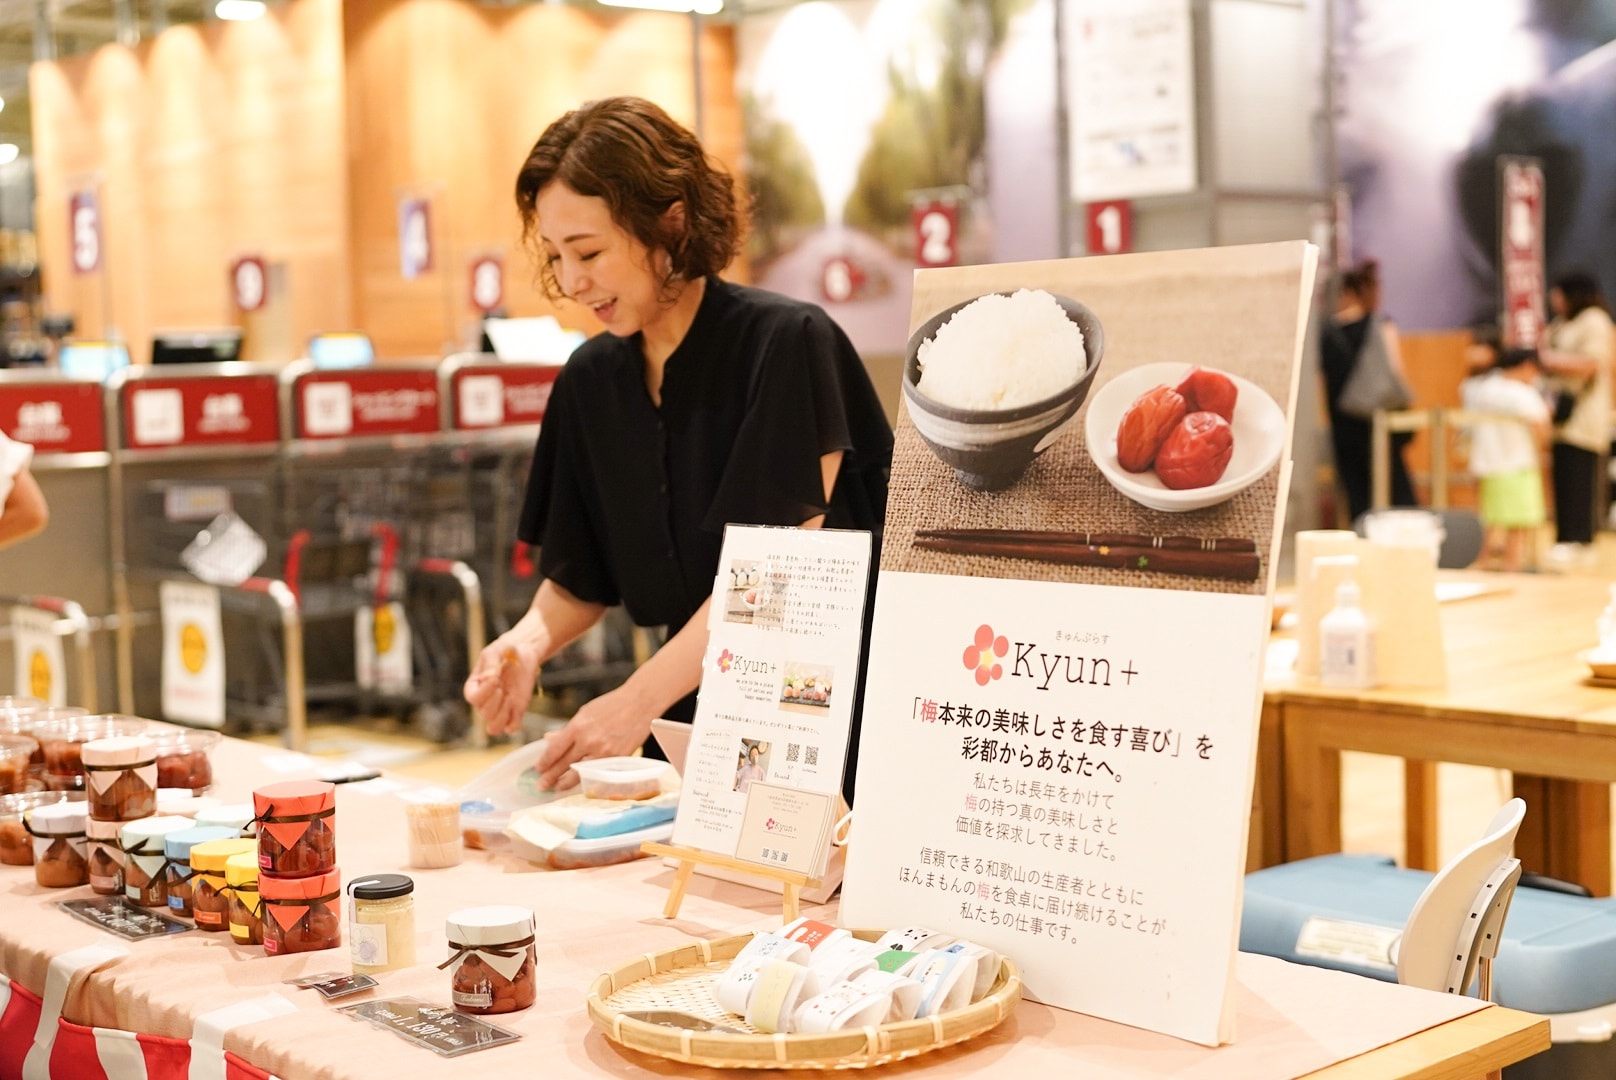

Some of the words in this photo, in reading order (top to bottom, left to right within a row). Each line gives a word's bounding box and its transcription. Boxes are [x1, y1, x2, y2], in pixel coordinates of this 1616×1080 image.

[75, 207, 98, 269] 5
[921, 212, 951, 264] 2
[1096, 206, 1121, 252] 1
[1055, 629, 1110, 645] きゅんぷらす
[733, 655, 777, 675] Kyun+
[1011, 642, 1138, 690] Kyun+
[912, 697, 1213, 760] 「梅本来の美味しさを食す喜び」を
[961, 735, 1122, 783] 彩都からあなたへ。
[973, 772, 1114, 810] 私たちは長年をかけて
[956, 815, 1116, 862] 価値を探求してきました。
[964, 794, 1118, 836] 梅の持つ真の美味しさと
[919, 846, 1144, 906] 信頼できる和歌山の生産者とともに
[899, 867, 1167, 936] ほんまもんの梅を食卓に届け続けることが
[960, 901, 1077, 945] 私たちの仕事です。
